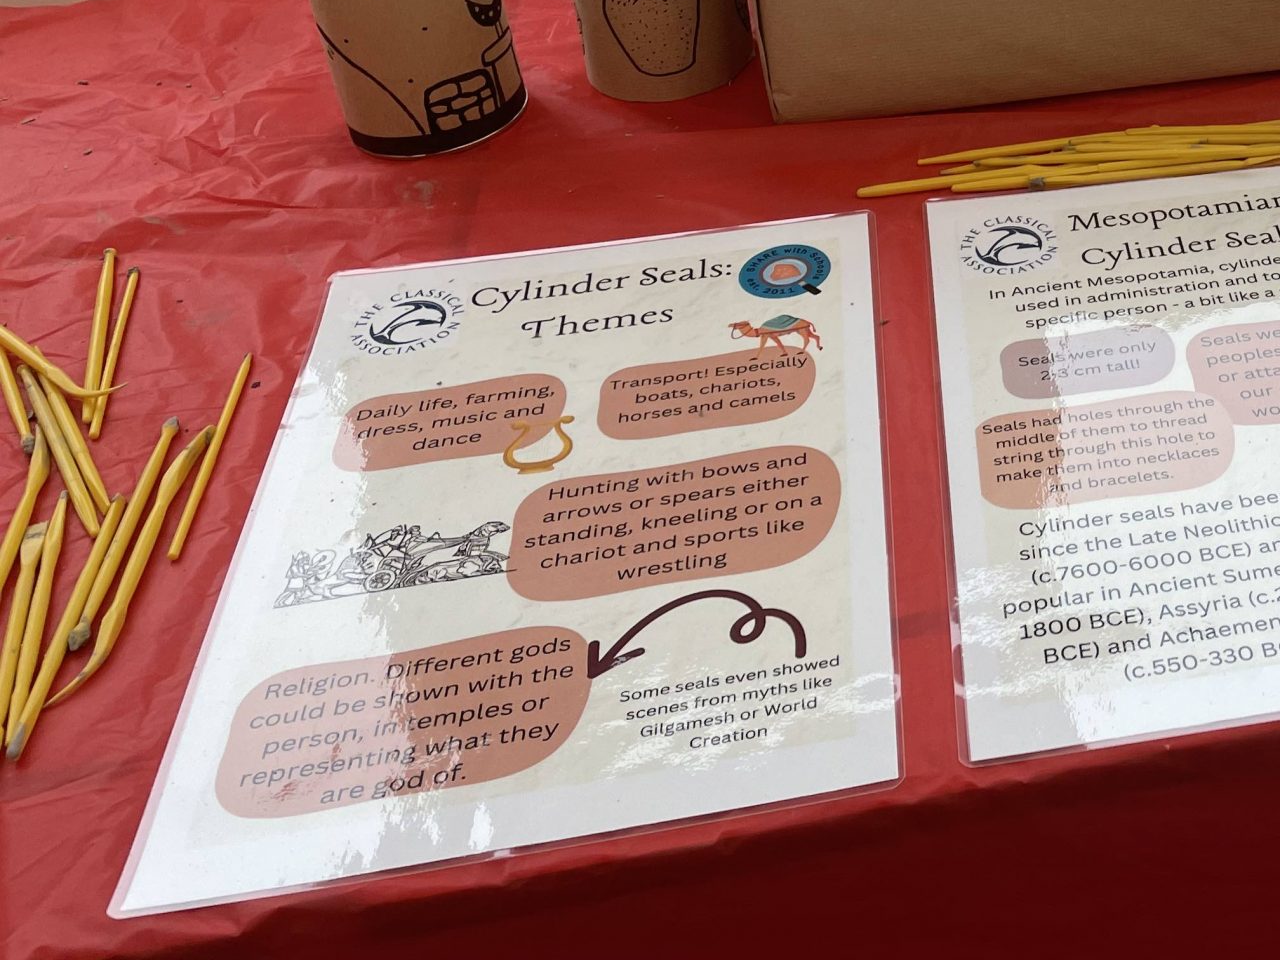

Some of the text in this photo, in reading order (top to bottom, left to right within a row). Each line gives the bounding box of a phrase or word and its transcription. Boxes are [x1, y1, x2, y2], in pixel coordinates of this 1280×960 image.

[961, 215, 1057, 250] THE CLASSICAL
[961, 245, 1058, 275] ASSOCIATION
[1082, 236, 1217, 271] Cylinder
[471, 258, 732, 314] Cylinder Seals:
[764, 287, 795, 295] 2011
[989, 290, 1005, 300] In
[1011, 280, 1082, 296] Ancient
[1087, 264, 1214, 287] Mesopotamia,
[1015, 297, 1059, 312] used
[1065, 296, 1081, 306] in
[1087, 280, 1219, 305] administration
[1225, 275, 1258, 288] and
[1263, 271, 1280, 281] to
[354, 289, 465, 328] THE CLASSICAL
[521, 308, 673, 339] Themes
[1025, 311, 1098, 329] specific
[1103, 302, 1168, 321] person
[1185, 299, 1195, 309] a
[1199, 295, 1224, 307] bit
[1229, 290, 1259, 302] like
[1264, 289, 1275, 298] a
[350, 321, 461, 356] ASSOCIATION
[610, 355, 807, 390] Transport! Especially
[636, 376, 781, 404] boats, chariots,
[356, 385, 554, 422] Daily life, farming,
[357, 403, 545, 440] dress, music and
[618, 391, 796, 423] horses and camels
[412, 432, 481, 451] dance
[548, 452, 808, 501] Hunting with bows and
[542, 475, 809, 523] arrows or spears either
[524, 495, 822, 549] standing, kneeling or on a
[1019, 510, 1114, 538] Cylinder
[1120, 505, 1175, 524] seals
[1181, 498, 1233, 516] have
[540, 518, 804, 569] chariot and sports like
[1019, 543, 1079, 562] since
[1084, 537, 1121, 553] the
[1128, 529, 1178, 547] Late
[616, 553, 727, 581] wrestling
[1032, 551, 1192, 585] (c.7600-6000
[1199, 541, 1252, 564] BCE)
[1002, 588, 1093, 618] popular
[1101, 583, 1122, 601] in
[1129, 572, 1216, 598] Ancient
[1019, 617, 1081, 640] 1800
[1089, 608, 1152, 631] BCE),
[1158, 595, 1243, 622] Assyria
[1043, 645, 1100, 664] BCE)
[1107, 636, 1151, 654] and
[1124, 646, 1253, 682] (c.550-330
